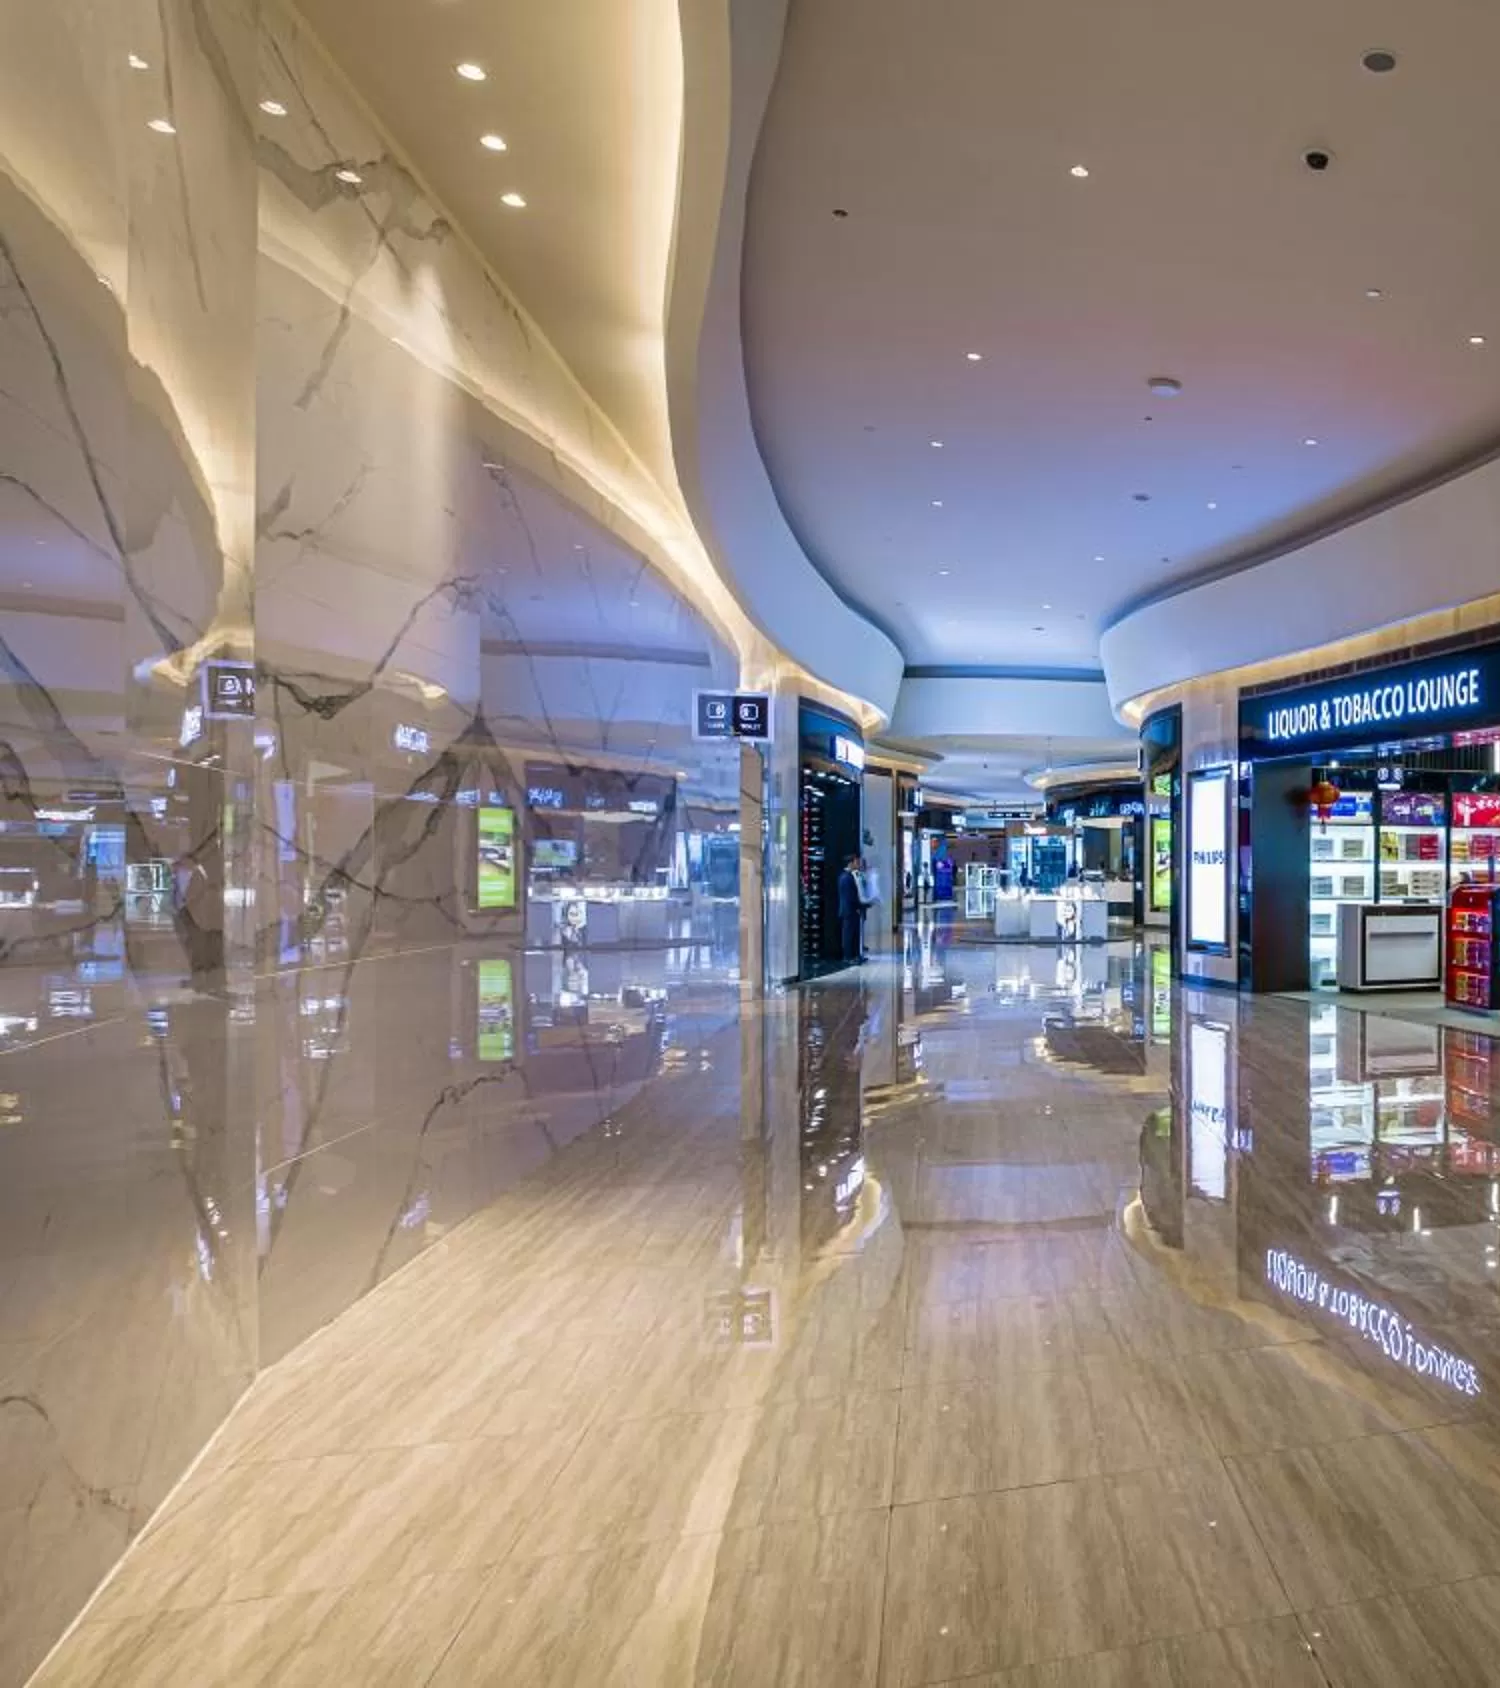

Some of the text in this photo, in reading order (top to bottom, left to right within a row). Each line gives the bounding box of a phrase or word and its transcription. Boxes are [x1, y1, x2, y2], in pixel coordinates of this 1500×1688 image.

[1268, 669, 1480, 740] LIQUOR & TOBACCO LOUNGE
